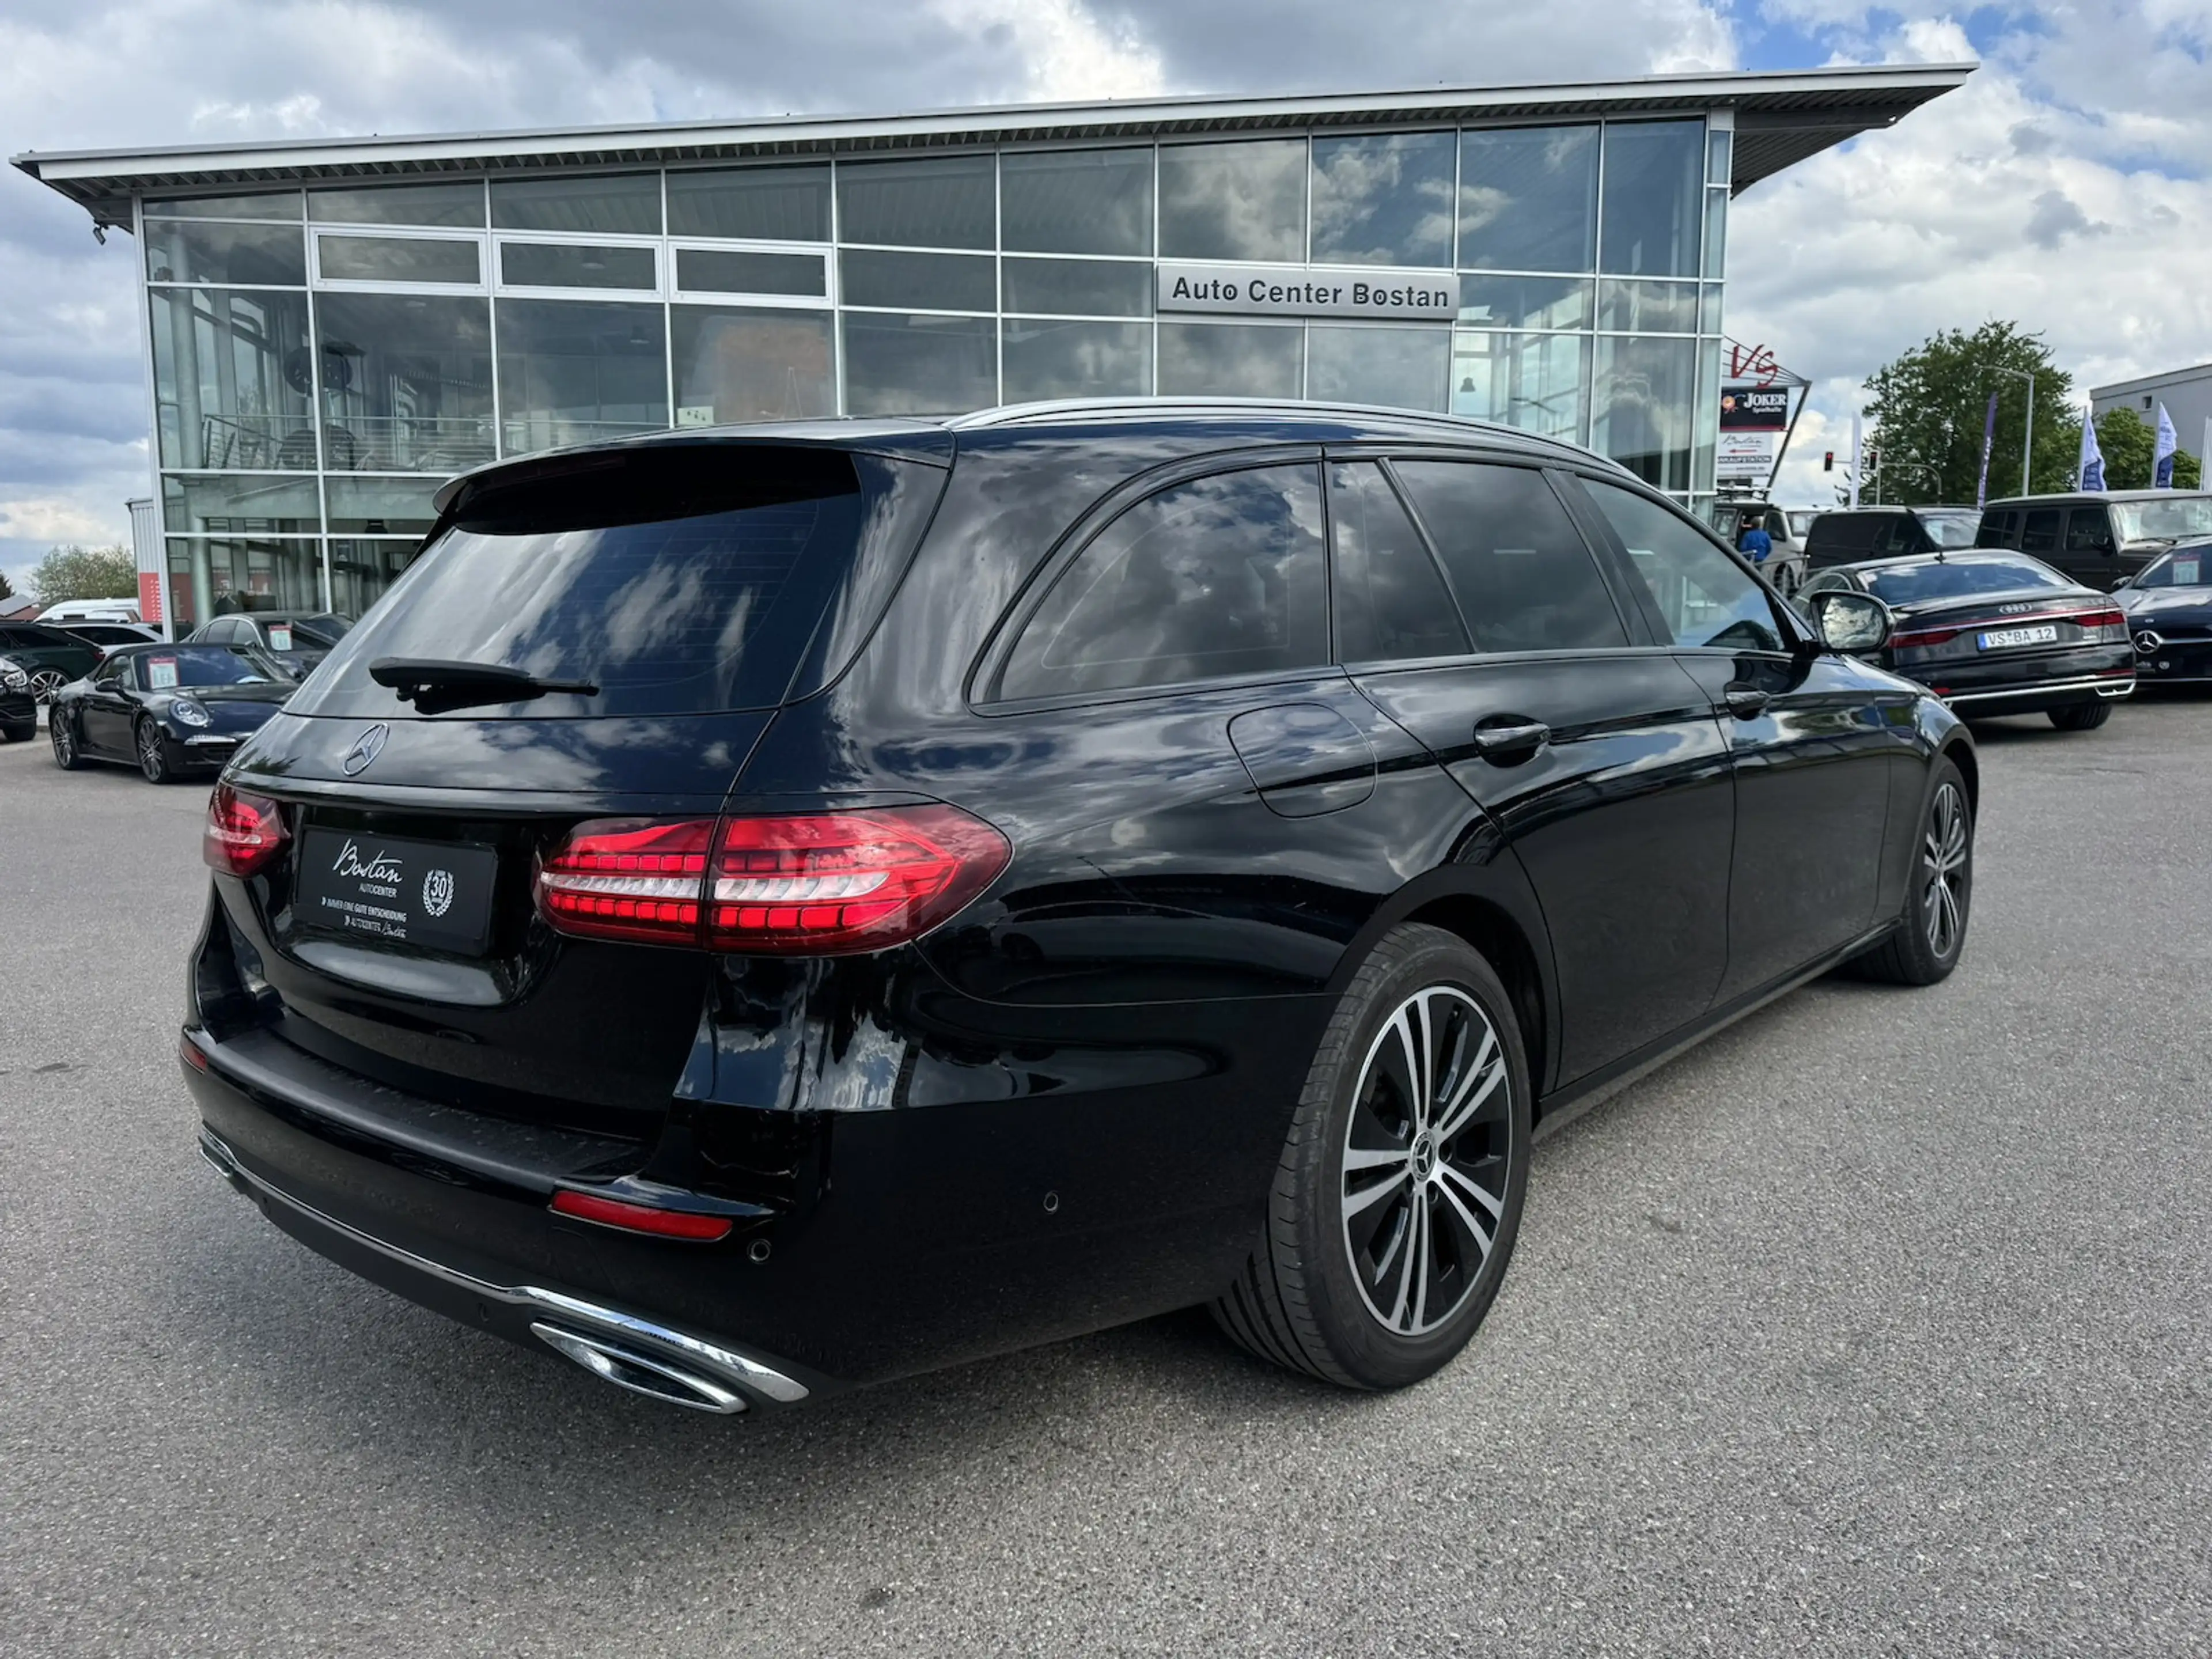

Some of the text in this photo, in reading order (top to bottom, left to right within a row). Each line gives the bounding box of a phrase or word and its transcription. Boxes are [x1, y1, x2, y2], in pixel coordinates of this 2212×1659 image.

[1172, 277, 1448, 307] Auto Center Bostan
[1731, 344, 1778, 389] VS
[1744, 392, 1786, 408] JOKER
[1988, 628, 2053, 645] VS BA 12
[333, 838, 403, 883] Bostan
[358, 883, 397, 898] AUTOCENTER
[430, 876, 446, 897] 30
